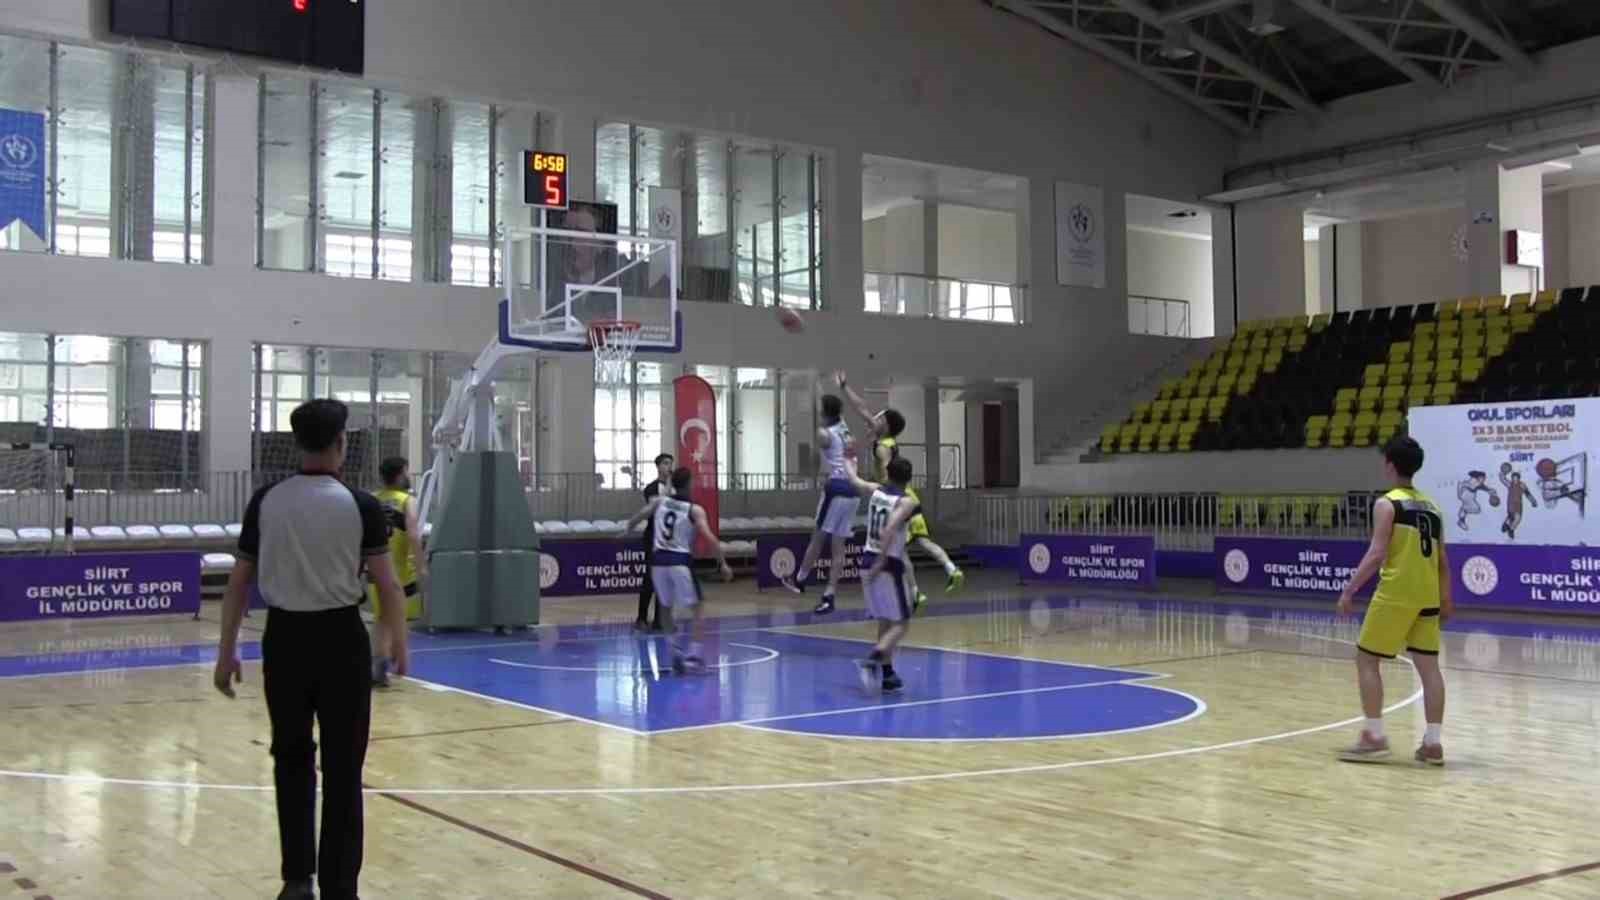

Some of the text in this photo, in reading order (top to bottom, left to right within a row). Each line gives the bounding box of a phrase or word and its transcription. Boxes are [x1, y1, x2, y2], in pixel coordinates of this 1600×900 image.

[533, 153, 565, 173] 6:58
[546, 176, 560, 204] 5
[1467, 405, 1575, 421] OKUL SPORLARI
[1496, 423, 1573, 435] BASKETBOL
[662, 511, 677, 540] 9
[1104, 558, 1117, 567] VE
[1298, 550, 1328, 563] SİİRT
[84, 566, 130, 580] SİİRT
[577, 563, 631, 576] GENÇLİK
[1263, 563, 1359, 578] GENÇLİK VE SPO
[1271, 576, 1348, 591] İL MÜDÜRLÜ
[1519, 572, 1593, 588] GENÇLİK
[26, 581, 183, 599] GENÇLİK VE SPOR
[1531, 586, 1600, 603] İL MÜDÜ
[39, 596, 171, 614] İL MÜDÜRLÜĞÜ
